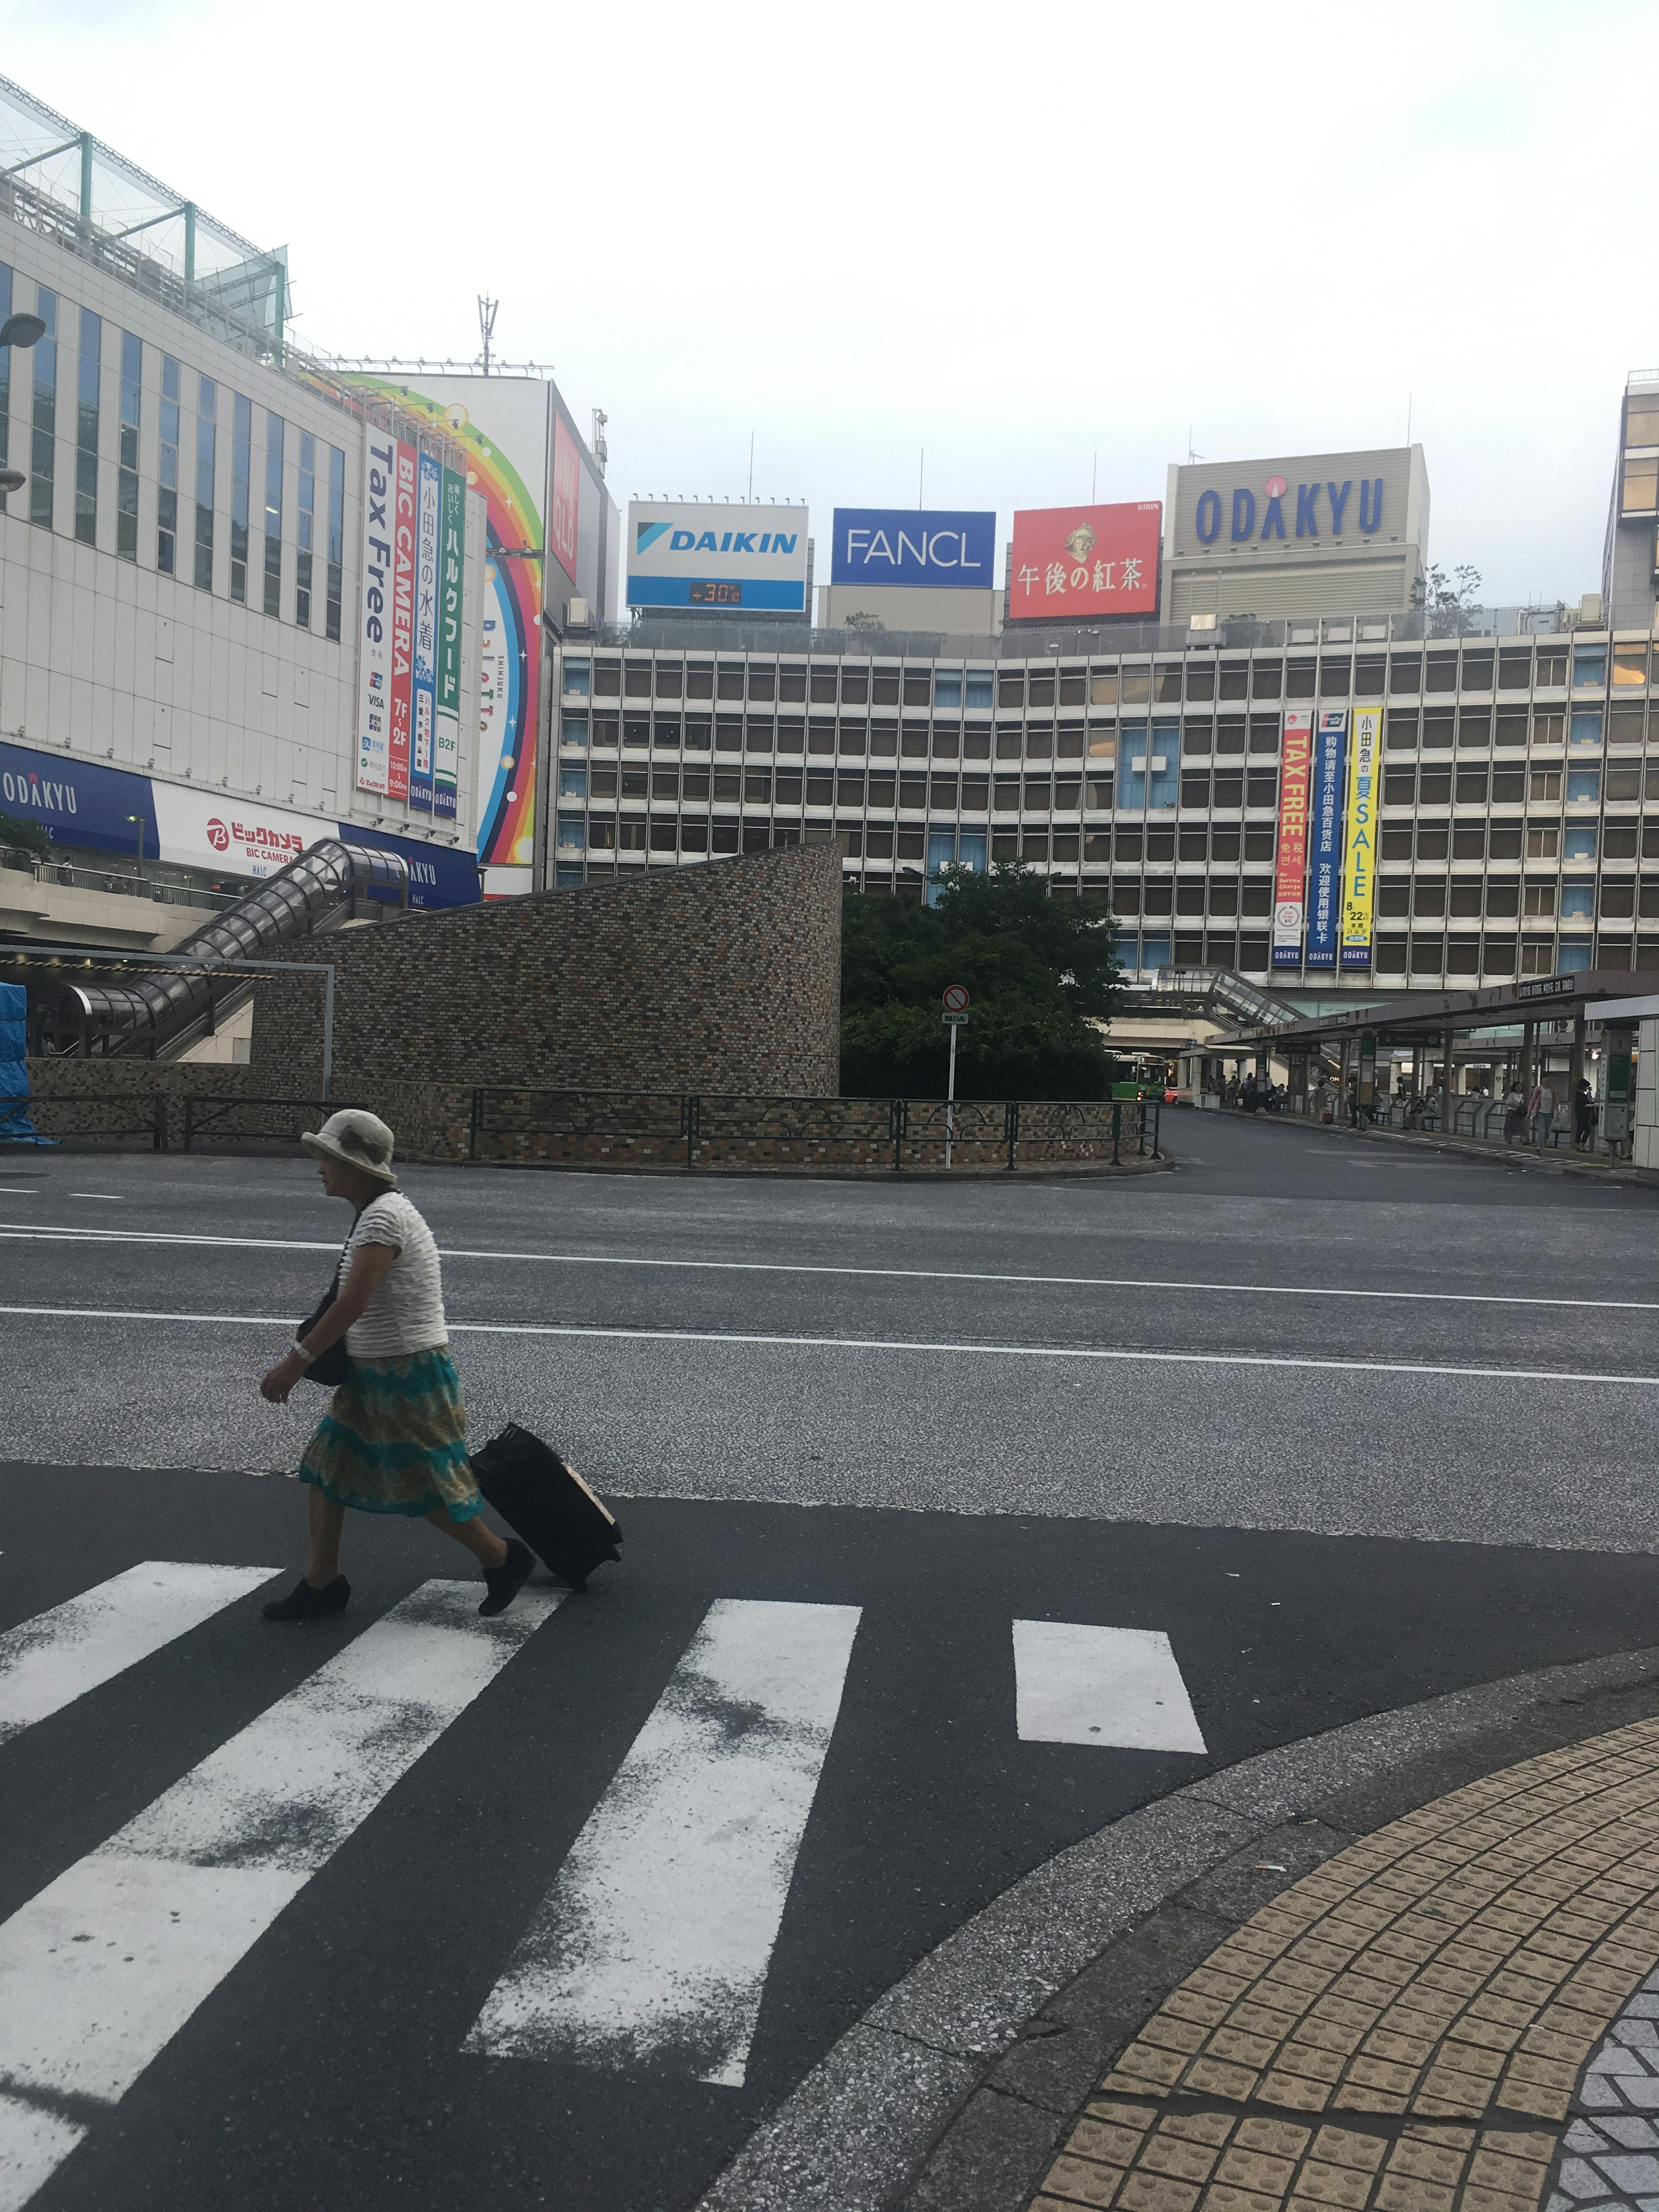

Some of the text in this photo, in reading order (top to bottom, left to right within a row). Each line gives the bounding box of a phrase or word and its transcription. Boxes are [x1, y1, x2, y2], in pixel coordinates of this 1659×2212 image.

[1196, 476, 1382, 544] ODAKYU
[367, 445, 393, 643] Tax Free
[670, 531, 798, 554] DAIKIN
[847, 529, 981, 567] FANCL
[394, 456, 413, 676] BIC CAMERA
[419, 487, 435, 651] 小田急の水着
[1017, 558, 1143, 596] 午後の紅茶
[445, 528, 459, 699] ハルクフード
[368, 693, 384, 709] VISA
[394, 697, 408, 718] 7F
[393, 727, 407, 746] 2F
[439, 737, 456, 752] B2F
[1284, 736, 1307, 779] TAX
[3, 772, 77, 814] ODAKYU
[411, 785, 432, 801] ODAKYU
[435, 792, 456, 809] ODAKYU
[1320, 736, 1337, 852] 购物请至小田急百货店
[1282, 784, 1305, 837] FREE
[232, 822, 302, 851] ビックカメラ
[246, 847, 294, 864] BIC CAMERA
[1280, 842, 1303, 853] 免税
[252, 865, 267, 877] HALC
[1281, 855, 1301, 866] 면세
[412, 894, 424, 905] HALC
[1316, 863, 1332, 944] 欢迎使用银联卡
[1346, 902, 1363, 920] 8/22
[1275, 950, 1298, 959] ODAKYU
[1309, 951, 1332, 960] ODAKYU
[1343, 950, 1368, 959] ODAKYU
